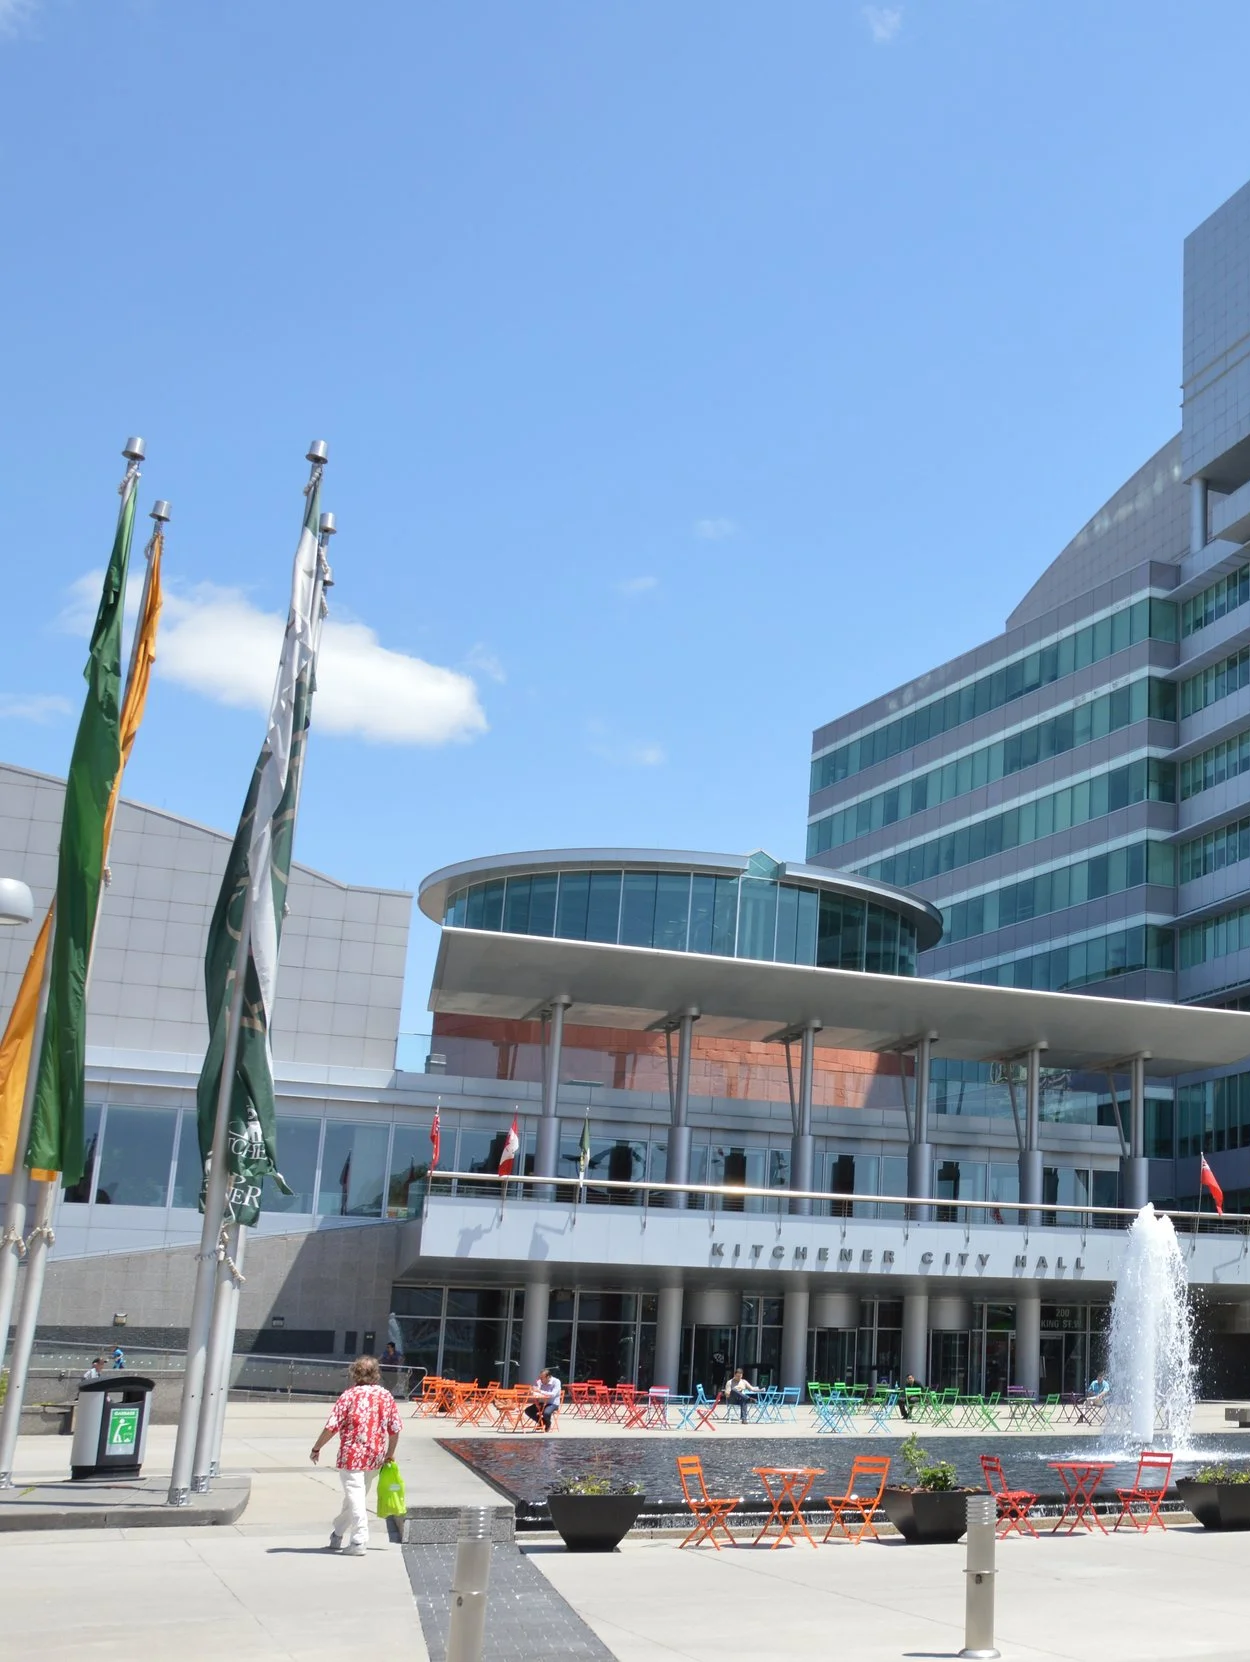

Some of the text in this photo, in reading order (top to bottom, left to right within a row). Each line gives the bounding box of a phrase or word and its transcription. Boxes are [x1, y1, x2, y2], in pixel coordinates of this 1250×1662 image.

[711, 1242, 1086, 1270] KITCHENER CITY HALL
[1055, 1308, 1070, 1318] 200
[1041, 1319, 1059, 1328] KING
